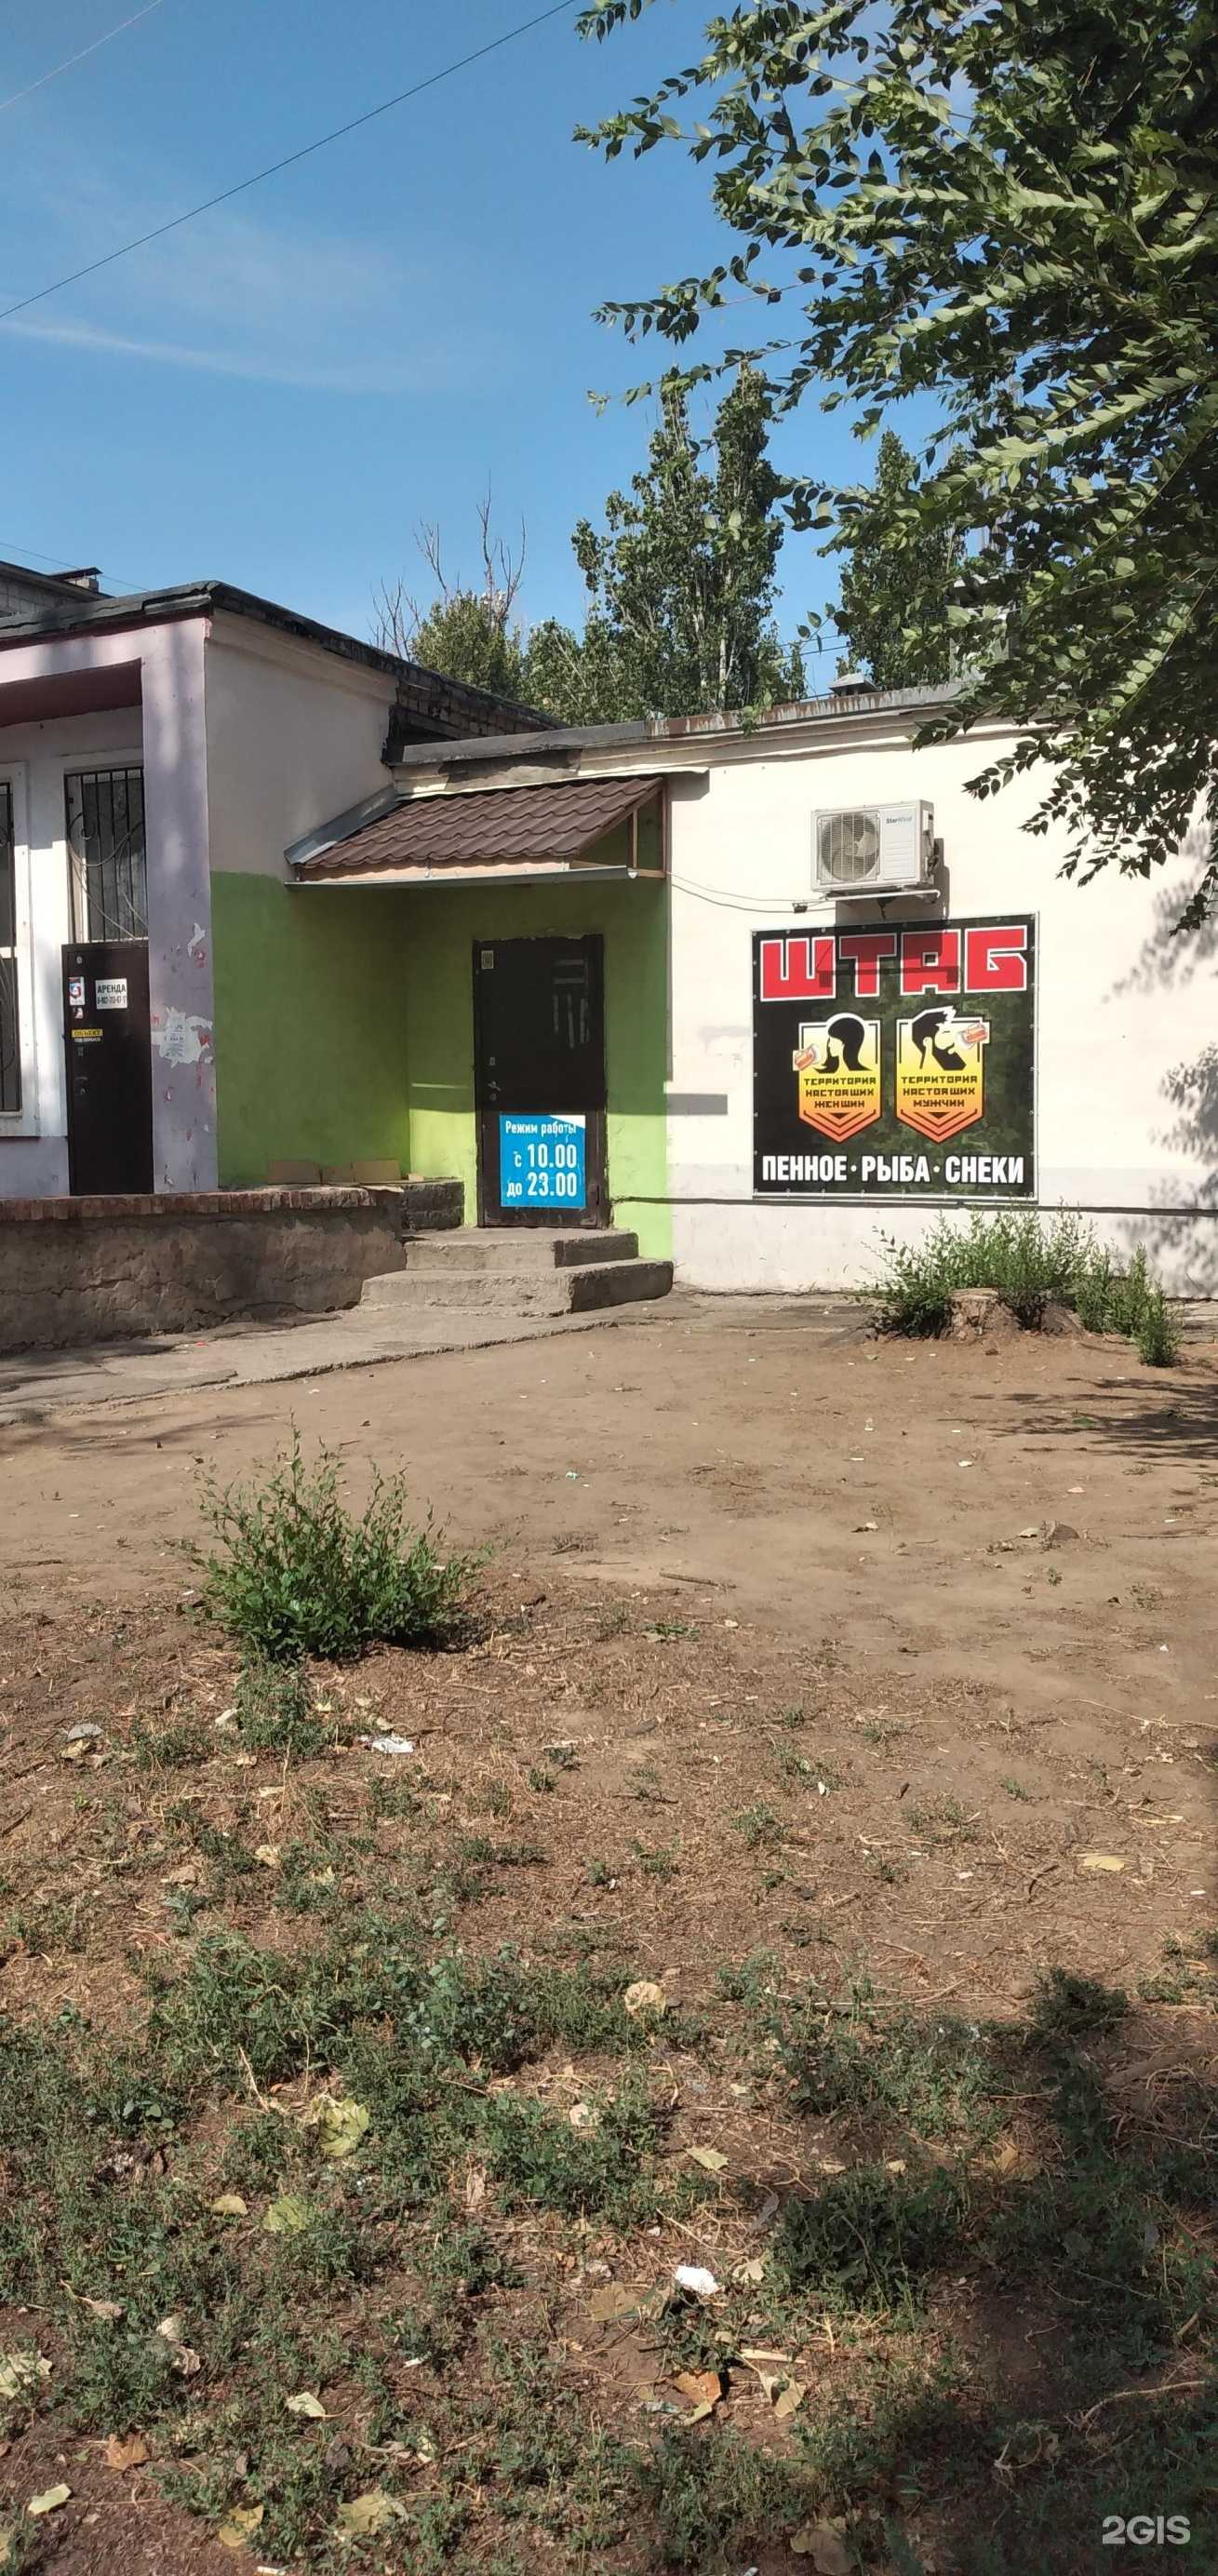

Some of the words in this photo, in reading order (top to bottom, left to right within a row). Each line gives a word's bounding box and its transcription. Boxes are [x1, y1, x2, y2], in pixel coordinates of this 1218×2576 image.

[760, 925, 1027, 1001] ШТАБ
[98, 985, 127, 994] АРЕНДА
[804, 1077, 877, 1086] ТЕРРИТОРИЯ
[901, 1076, 978, 1084] ТЕРРИТОРИЯ
[913, 1099, 965, 1107] МУЖЧИН
[505, 1120, 538, 1134] Режим
[541, 1120, 577, 1137] работы
[514, 1154, 522, 1168] с
[528, 1143, 577, 1169] 10.00
[761, 1155, 848, 1182] ПЕННОЕ
[862, 1156, 930, 1183] РЫБА
[944, 1156, 1024, 1184] СНЕКИ
[506, 1182, 523, 1198] до
[528, 1172, 577, 1198] 23.00
